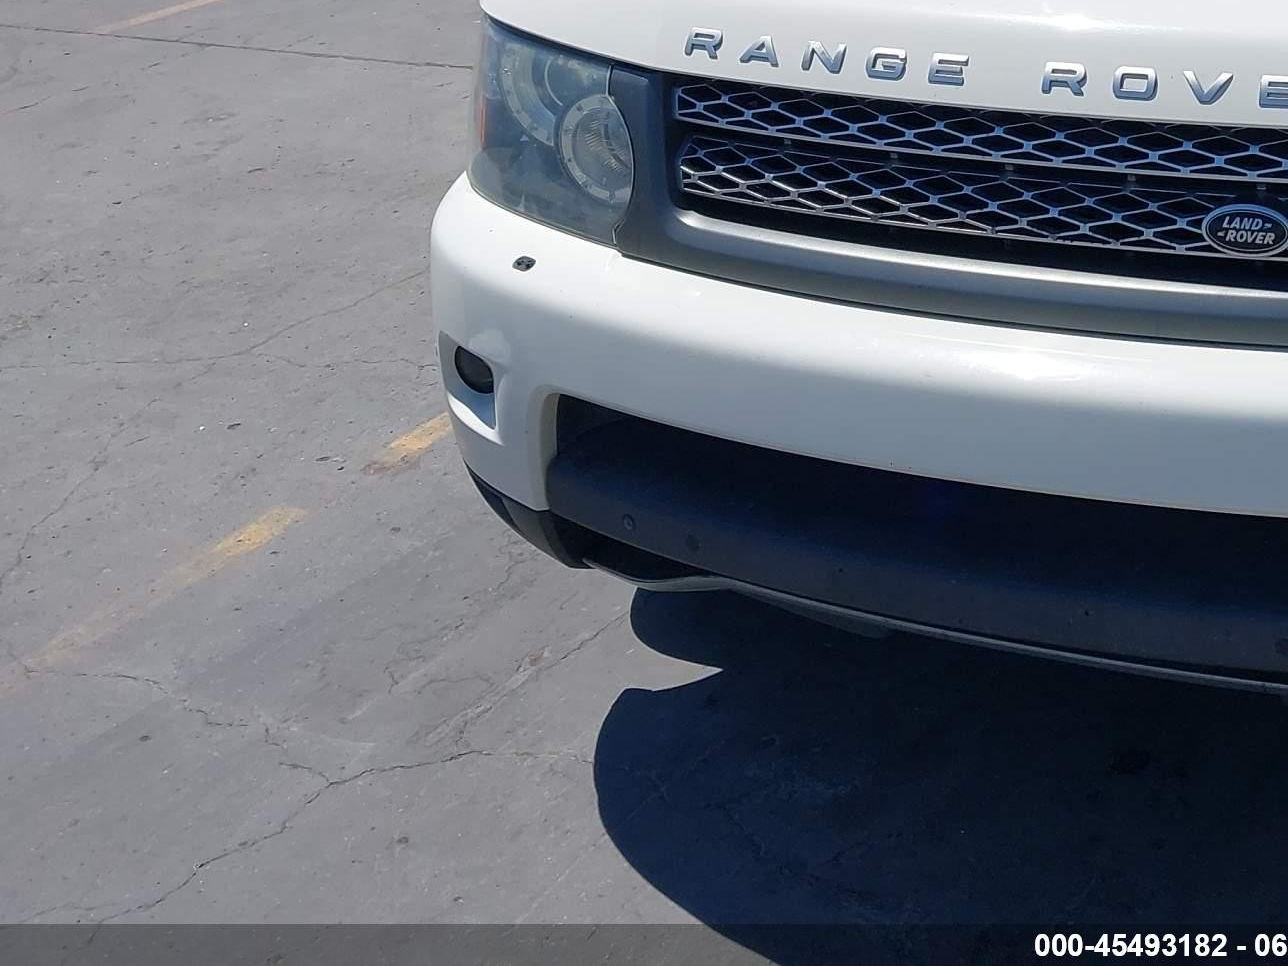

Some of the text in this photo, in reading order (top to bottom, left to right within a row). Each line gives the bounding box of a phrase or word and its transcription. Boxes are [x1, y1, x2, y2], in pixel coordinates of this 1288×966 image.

[685, 26, 970, 86] RANGE
[1222, 216, 1262, 230] LAND
[1225, 230, 1275, 245] ROVER
